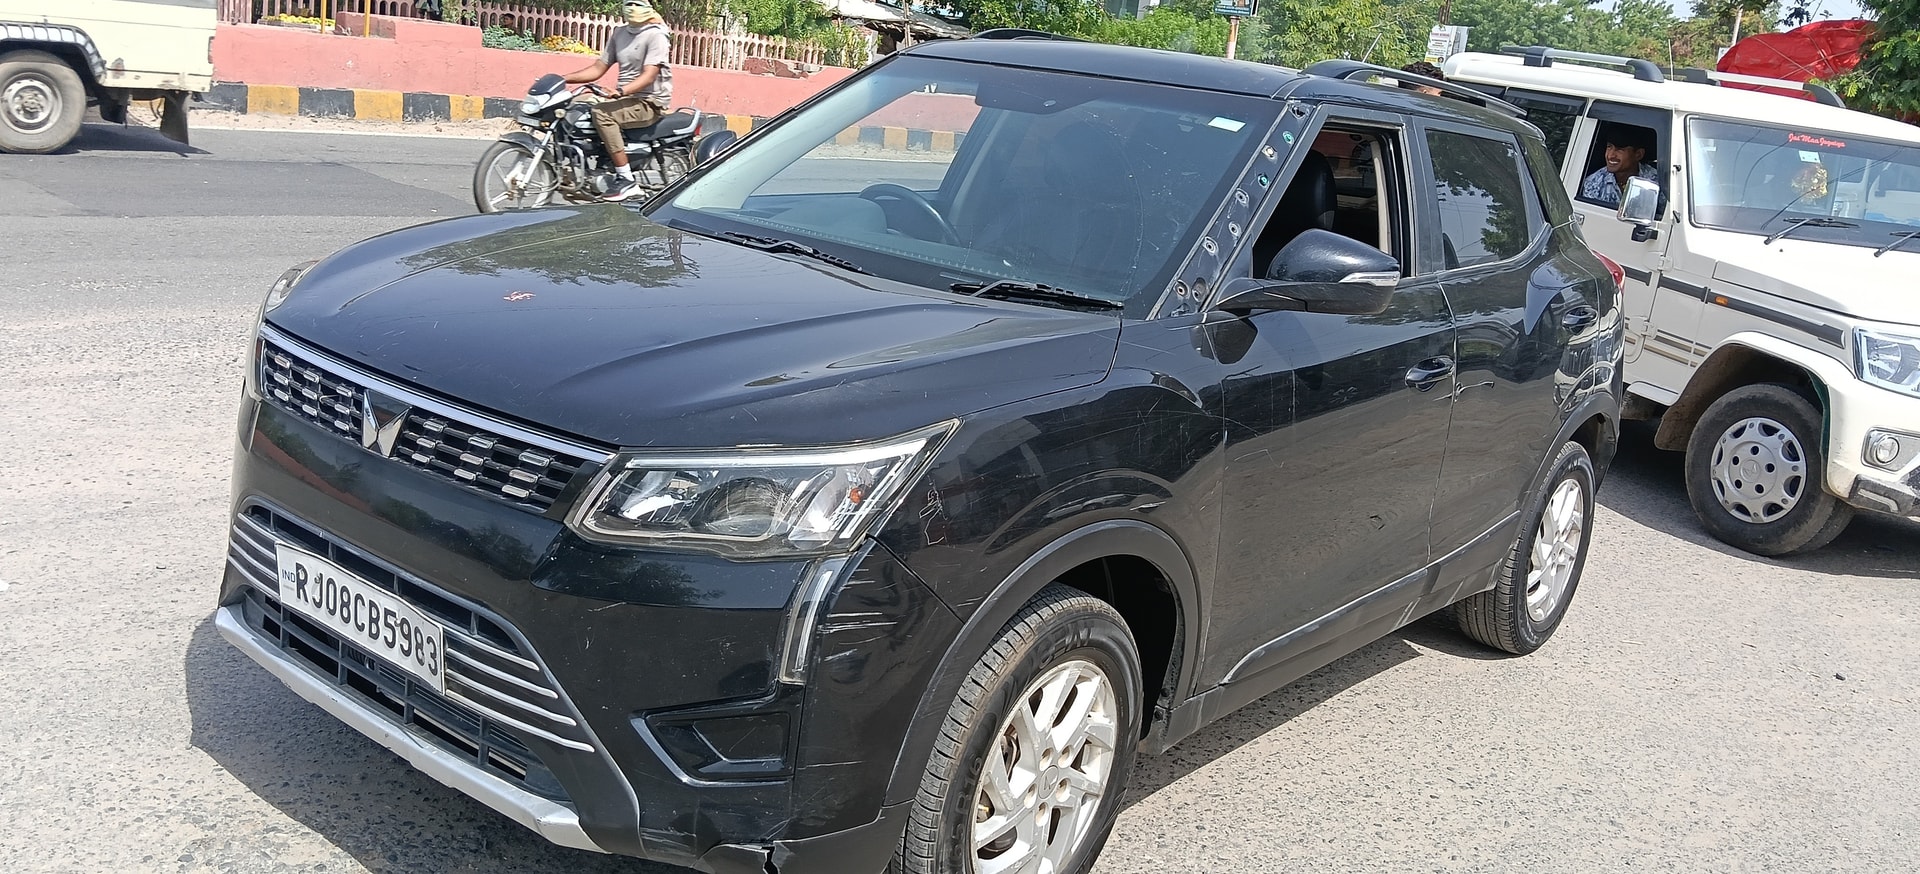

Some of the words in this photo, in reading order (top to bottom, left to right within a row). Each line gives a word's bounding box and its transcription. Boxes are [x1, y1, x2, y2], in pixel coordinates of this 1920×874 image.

[1800, 134, 1820, 145] Maa
[281, 568, 296, 583] IND
[295, 562, 438, 677] RJ08CB5983
